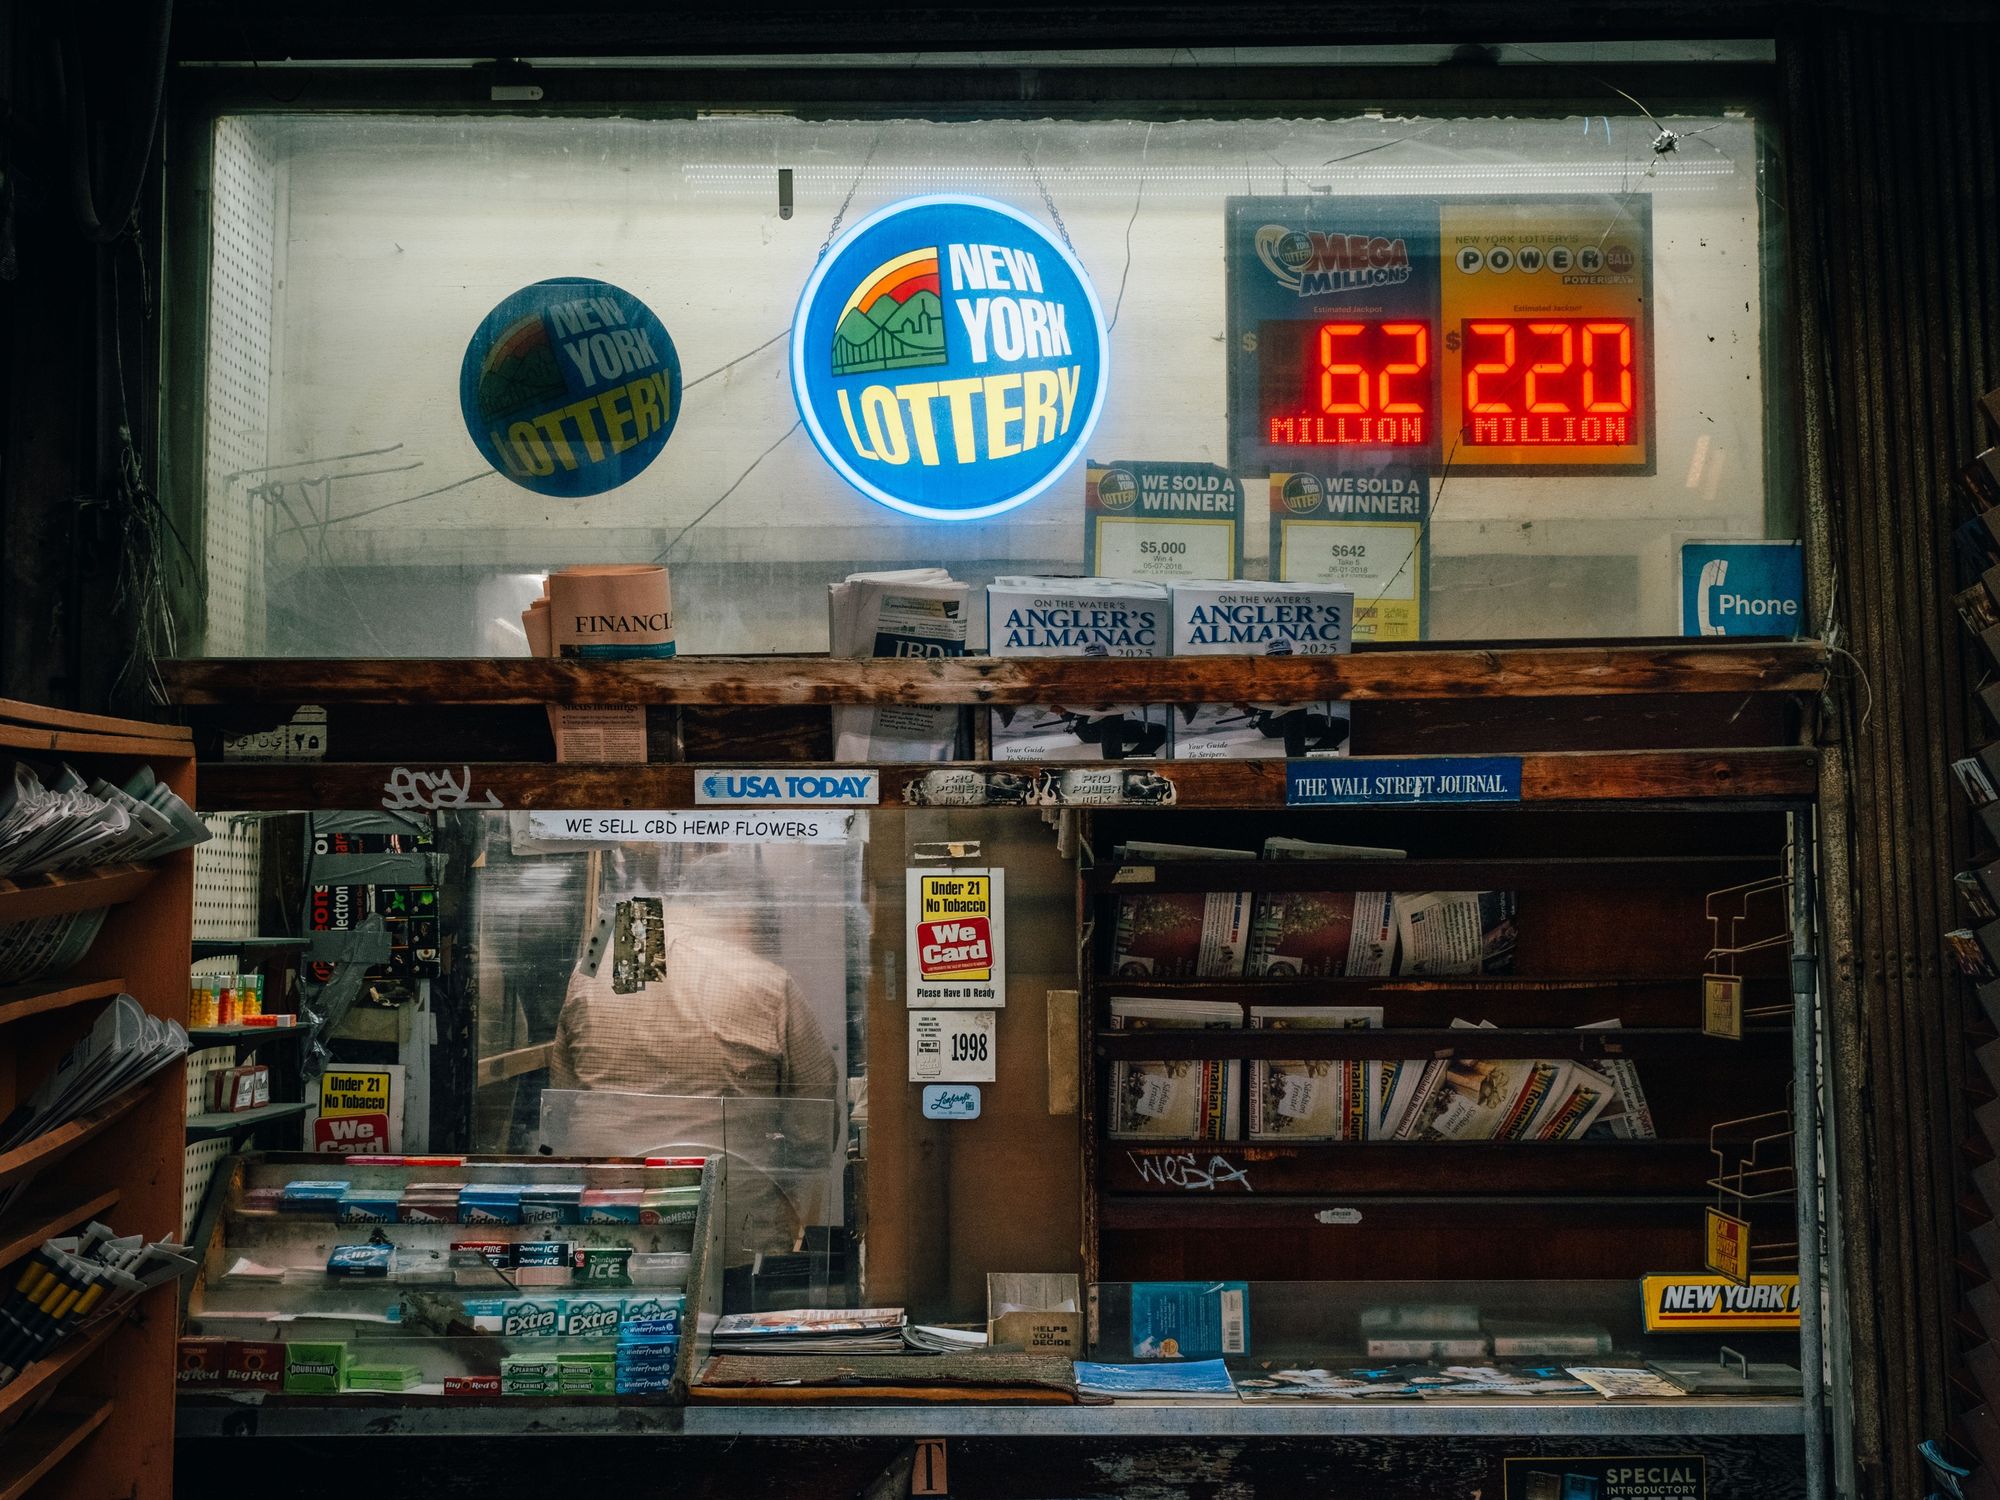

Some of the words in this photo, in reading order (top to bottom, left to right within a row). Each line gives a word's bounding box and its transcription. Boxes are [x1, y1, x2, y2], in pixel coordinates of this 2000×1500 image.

[1455, 235, 1480, 244] NEW
[1484, 235, 1514, 244] YORK
[1302, 231, 1409, 273] MEGA
[1461, 248, 1601, 271] POWER
[1608, 252, 1633, 265] BALL
[948, 243, 1043, 293] NEW
[1299, 267, 1409, 297] MILLIONS
[1313, 305, 1352, 314] Estimated
[1353, 305, 1383, 315] Jackpot
[1513, 304, 1552, 313] Estimated
[547, 296, 627, 339] NEW
[955, 296, 1072, 363] YORK
[563, 328, 660, 387] YORK
[1319, 324, 1428, 415] 62
[1467, 323, 1632, 414] 220
[490, 368, 671, 477] LOTTERY
[836, 365, 1081, 466] LOTTERY
[1269, 416, 1422, 444] MILLION
[1474, 416, 1626, 443] MILLION
[1141, 475, 1169, 490] WE
[1172, 475, 1220, 491] SOLD
[1222, 477, 1236, 492] A
[1326, 477, 1354, 493] WE
[1357, 478, 1404, 494] SOLD
[1407, 479, 1420, 494] A
[1142, 491, 1236, 512] WINNER!
[1326, 495, 1420, 514] WINNER!
[1140, 541, 1187, 556] $5,000
[1331, 545, 1366, 557] $642
[1033, 599, 1054, 608] ON
[1057, 600, 1076, 609] THE
[1078, 600, 1126, 610] WATER'S
[1218, 595, 1238, 604] ON
[1240, 595, 1260, 604] THE
[1263, 596, 1311, 604] WATER'S
[1719, 594, 1798, 616] Phone
[575, 612, 674, 633] FINANCI
[1004, 609, 1155, 629] ANGLER'S
[1187, 604, 1341, 625] ANGLER'S
[1004, 628, 1155, 647] ALMANAC
[1187, 624, 1341, 644] ALMANAC
[895, 639, 945, 658] IBD
[1300, 643, 1337, 655] 2025
[1023, 745, 1046, 753] Guide
[1208, 741, 1228, 749] Guide
[943, 774, 975, 784] PRO
[1081, 774, 1111, 784] PRO
[1295, 778, 1328, 796] THE
[1329, 777, 1373, 796] WALL
[1375, 776, 1435, 795] STREET
[726, 776, 782, 799] USA
[785, 776, 872, 799] TODAY
[935, 784, 984, 794] POWER
[1072, 784, 1121, 794] POWER
[565, 818, 593, 834] WE
[598, 819, 639, 835] SELL
[644, 820, 677, 835] CBD
[683, 820, 730, 836] HEMP
[735, 821, 819, 837] FLOWERS
[931, 880, 964, 896] Under
[967, 880, 980, 895] 21
[926, 898, 940, 913] No
[943, 898, 986, 913] Tobacco
[931, 923, 977, 944] We
[922, 940, 988, 965] Card
[917, 988, 941, 999] Please
[943, 988, 962, 999] Have
[963, 988, 971, 998] ID
[973, 988, 996, 1000] Ready
[951, 1033, 988, 1061] 1998
[330, 1076, 360, 1092] Under
[367, 1076, 380, 1092] 21
[324, 1094, 339, 1109] No
[342, 1093, 385, 1109] Tobacco
[328, 1120, 374, 1141] We
[344, 1213, 389, 1224] Trident
[403, 1215, 448, 1224] Trident
[465, 1214, 509, 1224] Trident
[524, 1208, 564, 1221] Trident
[586, 1216, 630, 1225] Trident
[658, 1210, 697, 1225] AIRHEADS
[1716, 1219, 1728, 1237] CAR
[458, 1245, 482, 1253] Dentyne
[482, 1245, 502, 1254] FIRE
[519, 1245, 544, 1253] Dentyne
[544, 1245, 559, 1254] ICE
[519, 1257, 544, 1266] Dentyne
[544, 1257, 560, 1266] ICE
[590, 1255, 623, 1264] Dentyne
[588, 1263, 621, 1279] ICE
[1661, 1285, 1722, 1312] NEW
[1722, 1284, 1788, 1311] YORK
[505, 1310, 555, 1335] Extra
[567, 1310, 619, 1335] Extra
[629, 1324, 667, 1335] Winterfresh
[1032, 1325, 1067, 1333] HELPS
[1032, 1332, 1055, 1340] YOU
[626, 1346, 664, 1357] Winterfresh
[290, 1364, 335, 1374] DOUBLEMINT
[511, 1365, 545, 1374] SPEARMINT
[625, 1363, 663, 1375] Winterfresh
[446, 1381, 461, 1389] Big
[472, 1381, 490, 1389] Red
[511, 1381, 545, 1389] SPEARMINT
[624, 1379, 662, 1389] Winterfresh
[1606, 1467, 1697, 1484] SPECIAL
[1606, 1485, 1697, 1495] INTRODUCTORY
